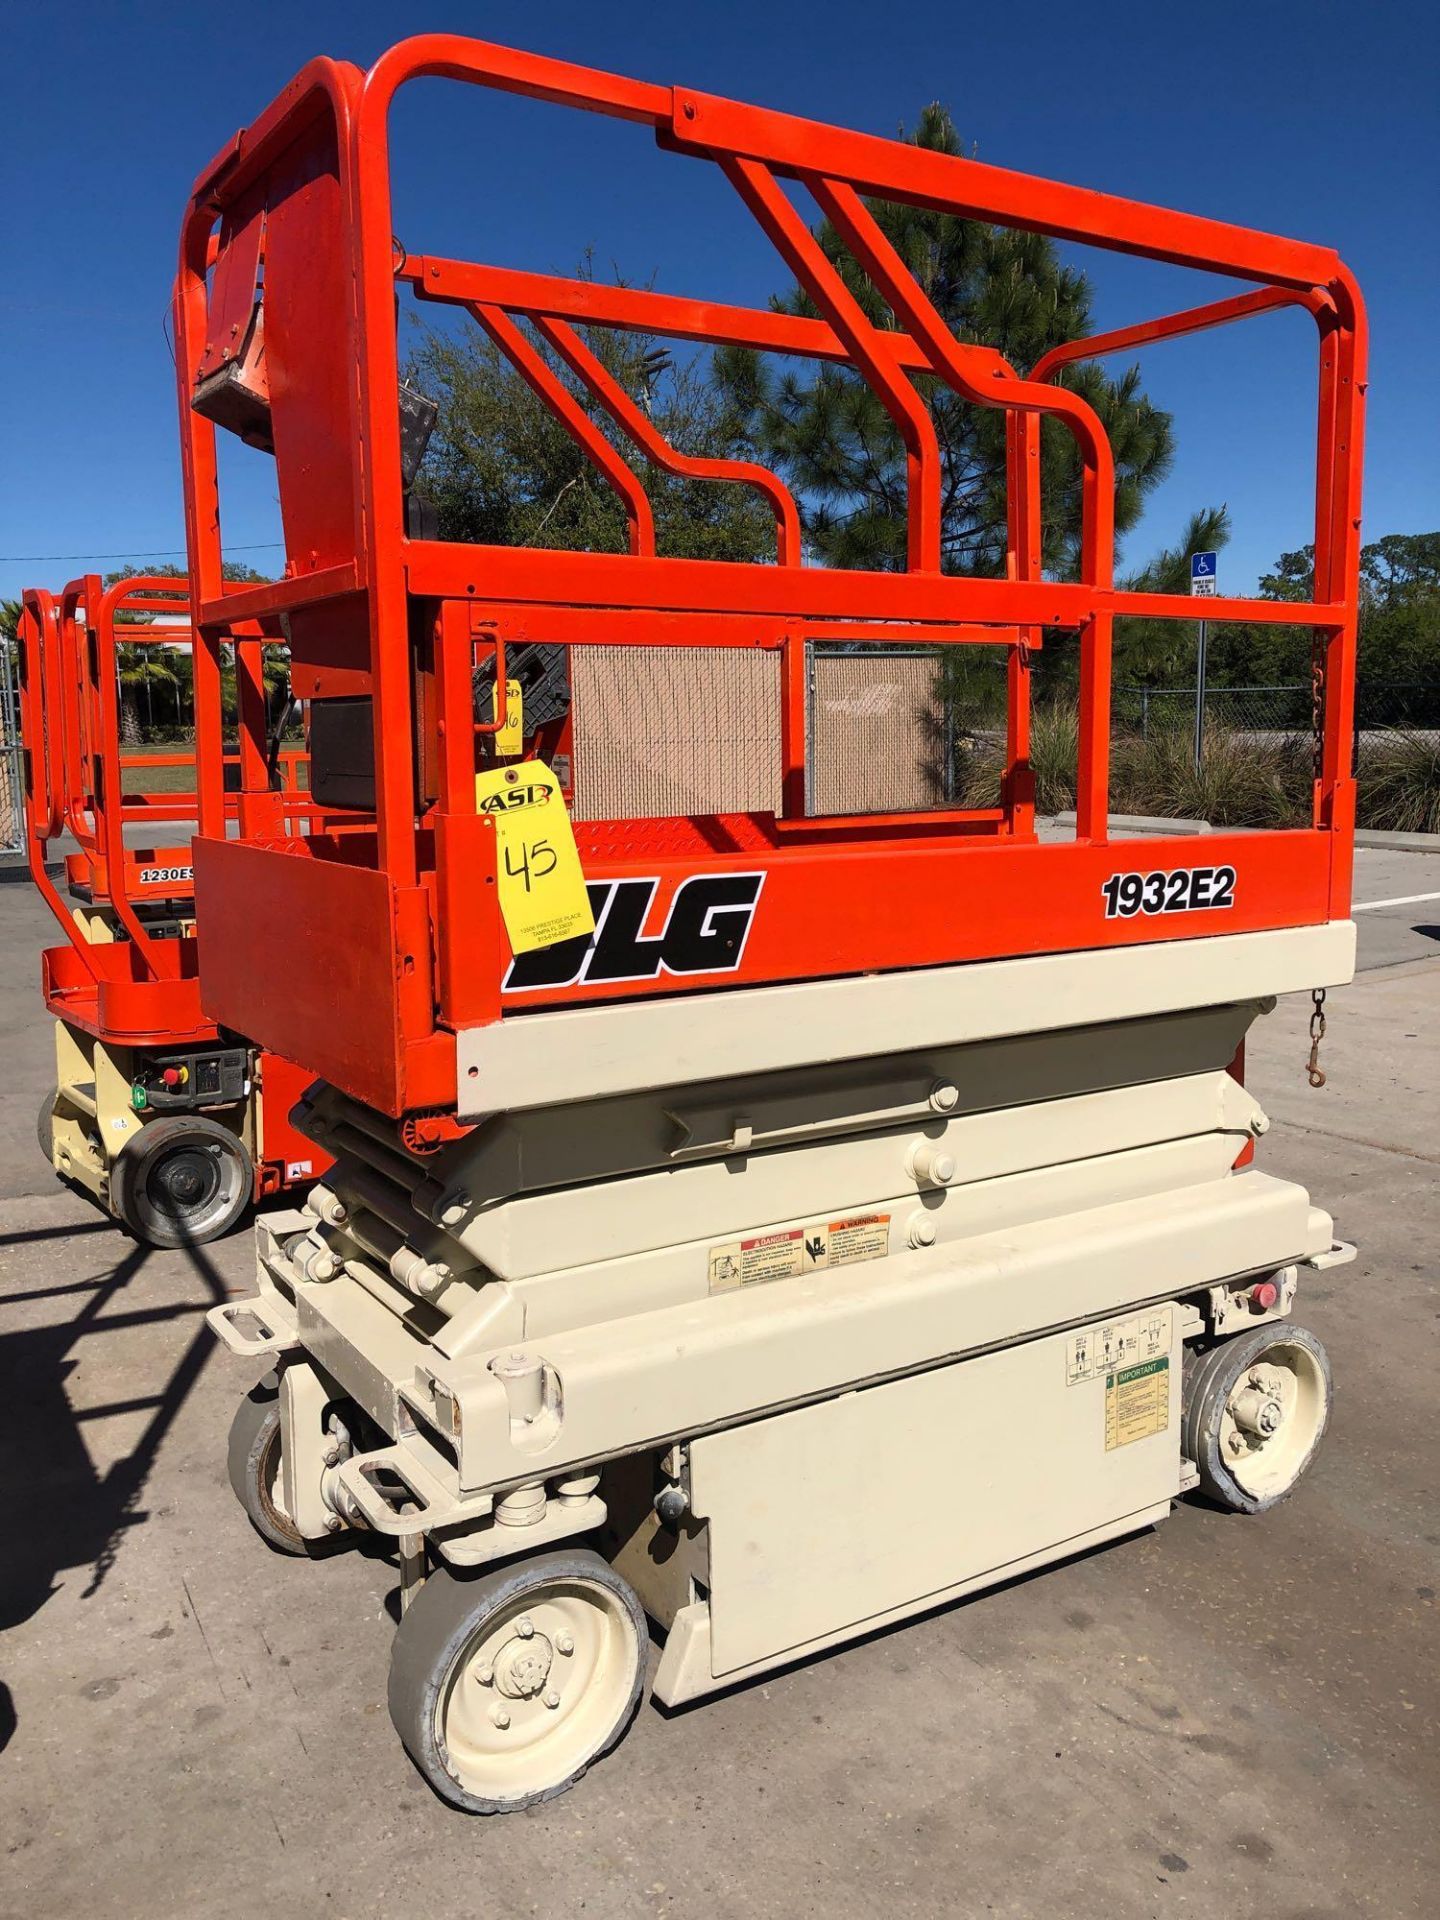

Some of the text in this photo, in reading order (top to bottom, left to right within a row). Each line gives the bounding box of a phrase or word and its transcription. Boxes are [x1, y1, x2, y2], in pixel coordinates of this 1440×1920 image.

[504, 839, 557, 893] 45
[1102, 866, 1236, 917] 1932E2
[563, 912, 582, 923] PLACE
[533, 927, 550, 937] TAMPA
[847, 1215, 880, 1227] WARNING
[760, 1233, 790, 1246] DANGER
[1118, 1363, 1158, 1383] IMPORTANT
